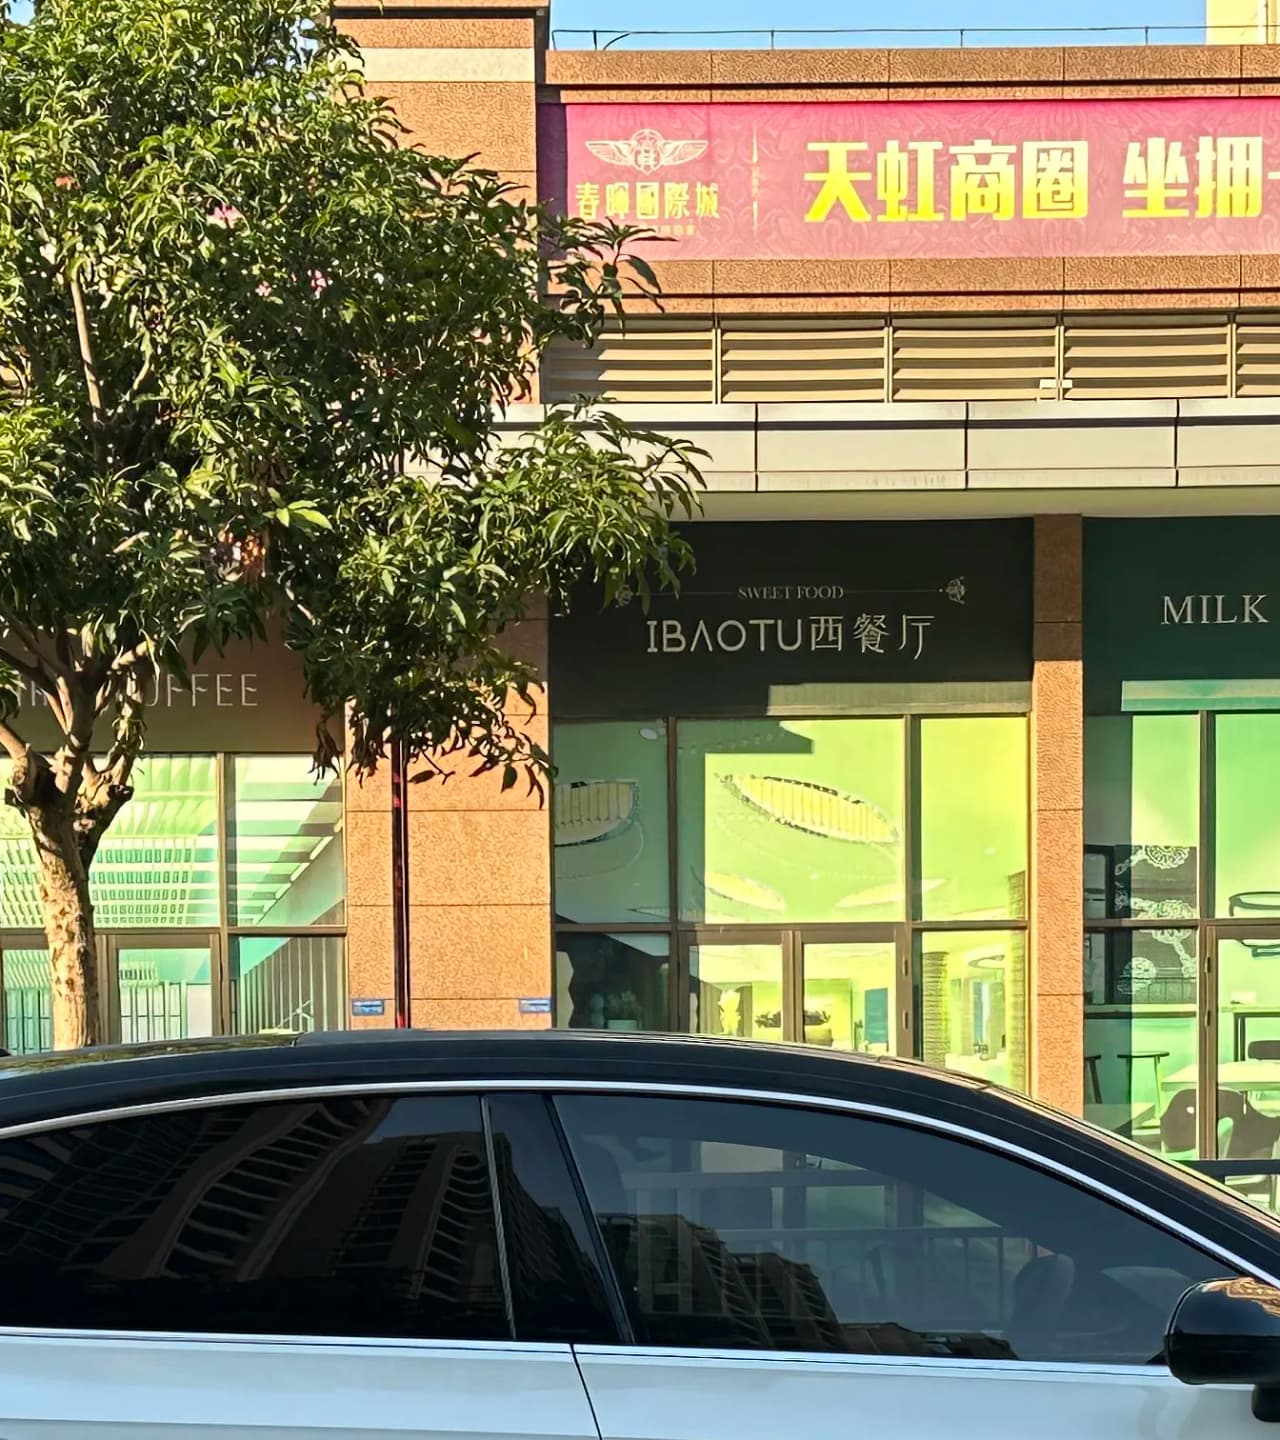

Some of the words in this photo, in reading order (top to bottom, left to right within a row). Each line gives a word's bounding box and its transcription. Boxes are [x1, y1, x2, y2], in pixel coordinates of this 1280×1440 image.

[803, 139, 1089, 223] 天虹商圈
[797, 585, 844, 600] FOOD
[1160, 594, 1269, 625] MILK
